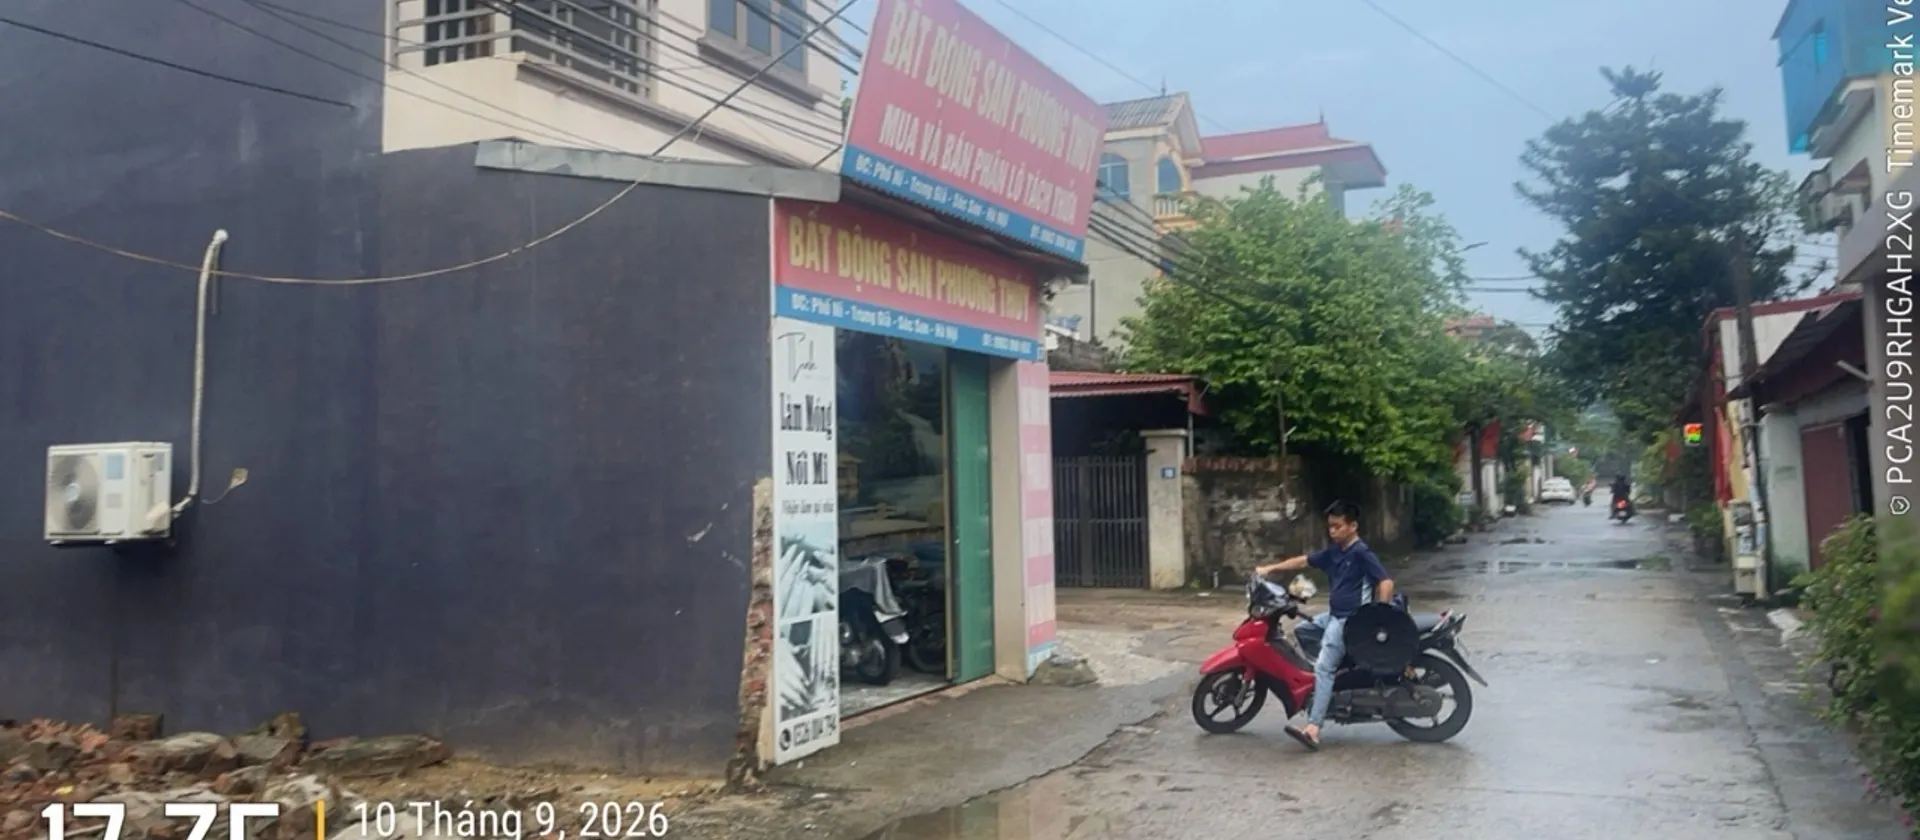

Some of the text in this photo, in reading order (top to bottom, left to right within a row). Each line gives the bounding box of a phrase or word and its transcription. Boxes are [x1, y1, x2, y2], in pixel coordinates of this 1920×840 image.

[925, 20, 981, 110] ĐỘNG
[977, 42, 1016, 128] SẢN
[878, 103, 919, 156] MUA
[941, 130, 975, 179] BÁN
[789, 205, 832, 274] BẤT
[837, 223, 891, 293] ĐỘNG
[896, 232, 933, 300] SẢN
[935, 259, 996, 314] PHƯƠNG
[780, 392, 833, 441] Làm Móng
[812, 451, 828, 485] Mi
